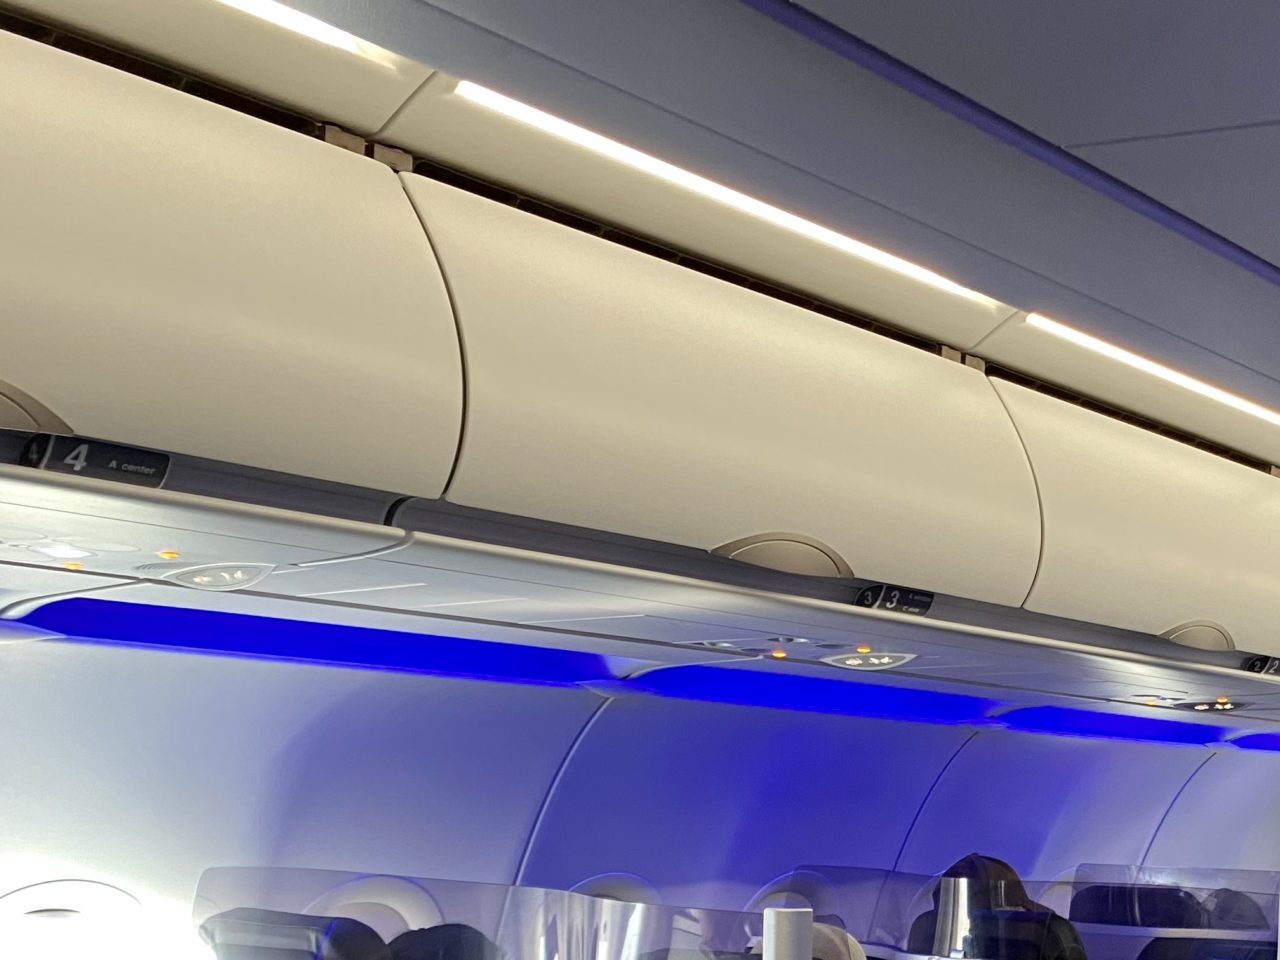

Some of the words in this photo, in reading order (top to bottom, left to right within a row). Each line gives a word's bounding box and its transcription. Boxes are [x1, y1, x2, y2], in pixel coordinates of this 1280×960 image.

[63, 443, 89, 471] 4
[864, 591, 872, 605] 3
[886, 590, 900, 608] 3
[1254, 661, 1262, 671] 2
[1269, 660, 1279, 673] 2
